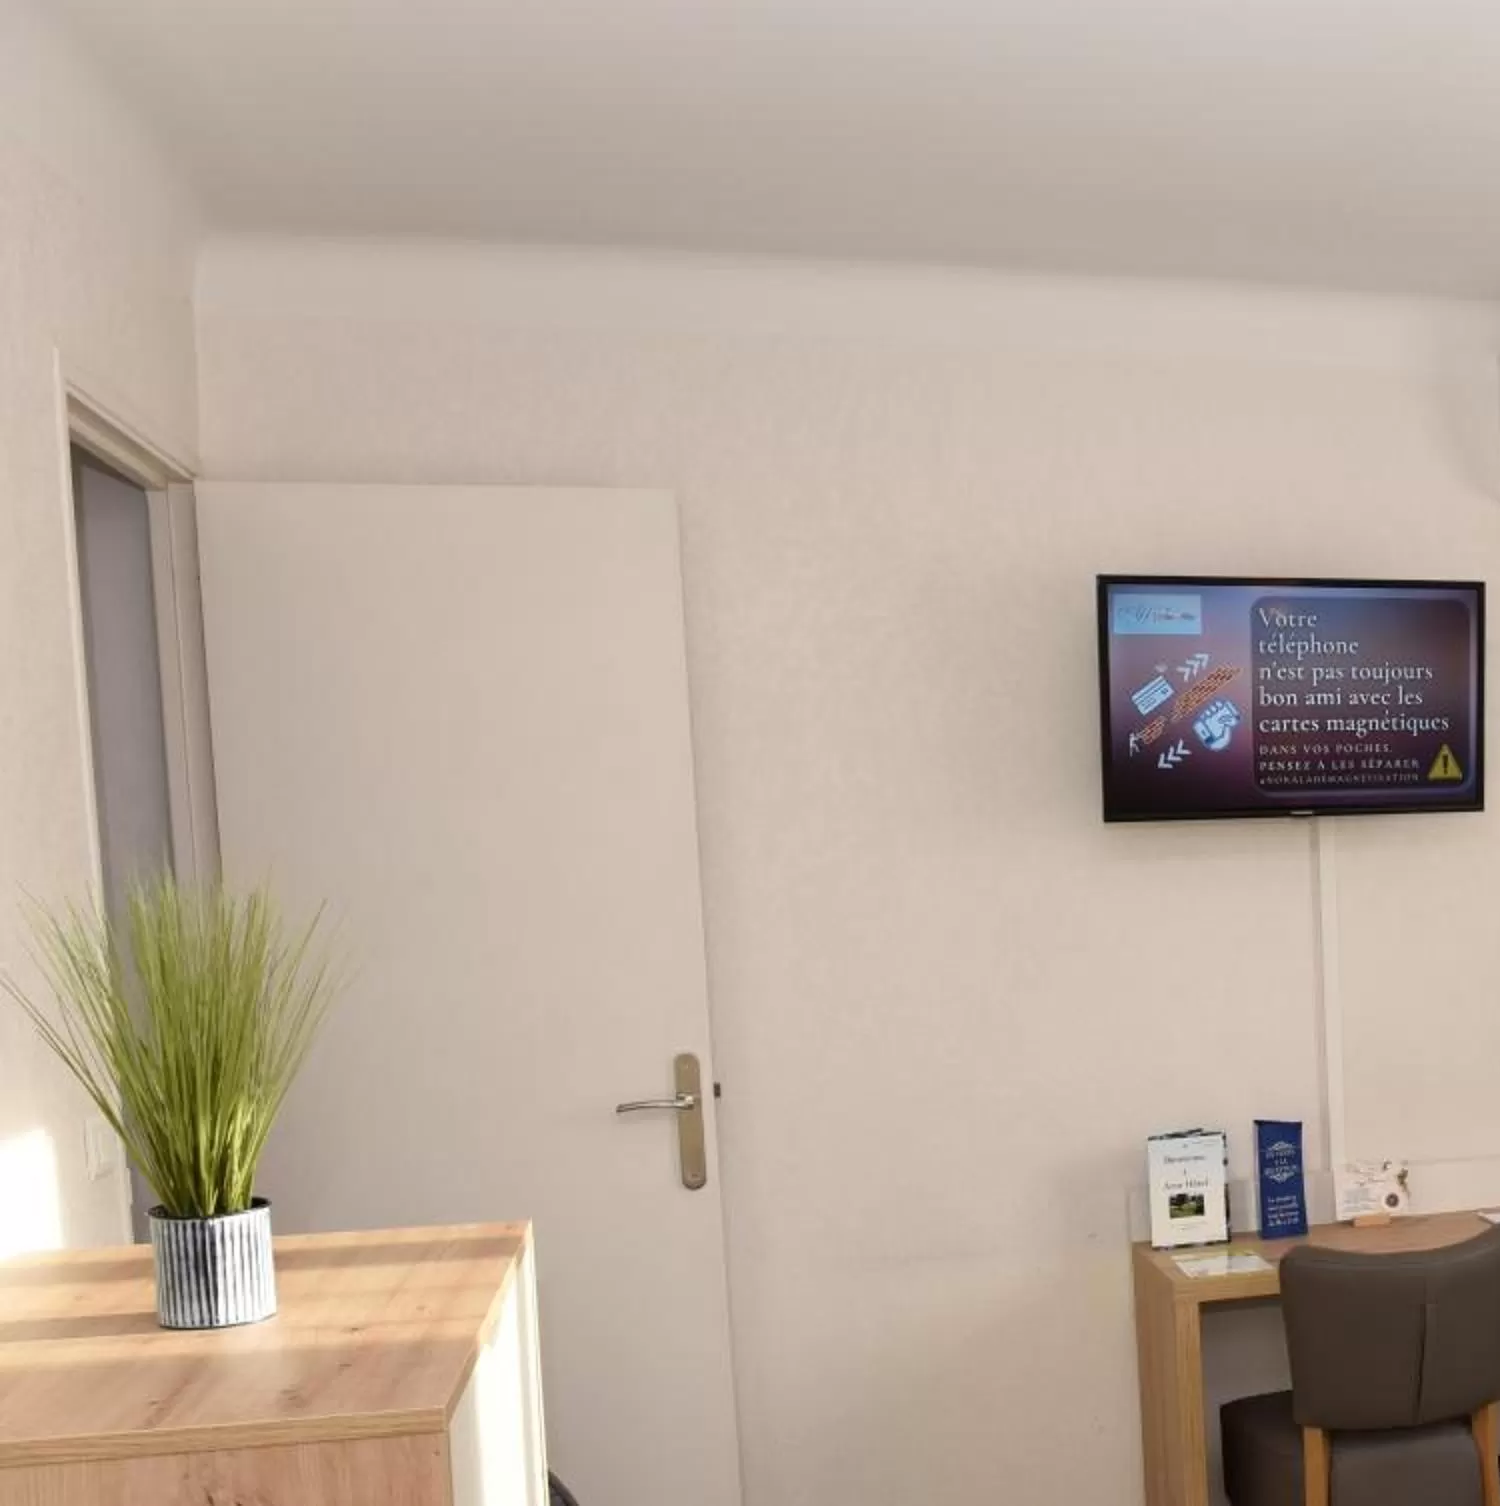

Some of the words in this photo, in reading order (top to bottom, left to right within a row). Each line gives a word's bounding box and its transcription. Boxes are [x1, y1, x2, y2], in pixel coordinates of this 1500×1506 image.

[1258, 607, 1317, 628] Votre
[1258, 631, 1359, 661] téléphone
[1259, 662, 1304, 681] n'est
[1312, 666, 1344, 686] pas
[1351, 662, 1433, 685] toujours
[1259, 686, 1297, 706] bon
[1305, 687, 1341, 706] ami
[1349, 691, 1391, 706] avec
[1398, 685, 1423, 705] les
[1259, 714, 1320, 733] cartes
[1327, 711, 1450, 738] magnétiques
[1259, 744, 1297, 755] DANS
[1303, 743, 1330, 754] VOS
[1259, 760, 1311, 771] PENSEZ
[1331, 759, 1355, 770] LES
